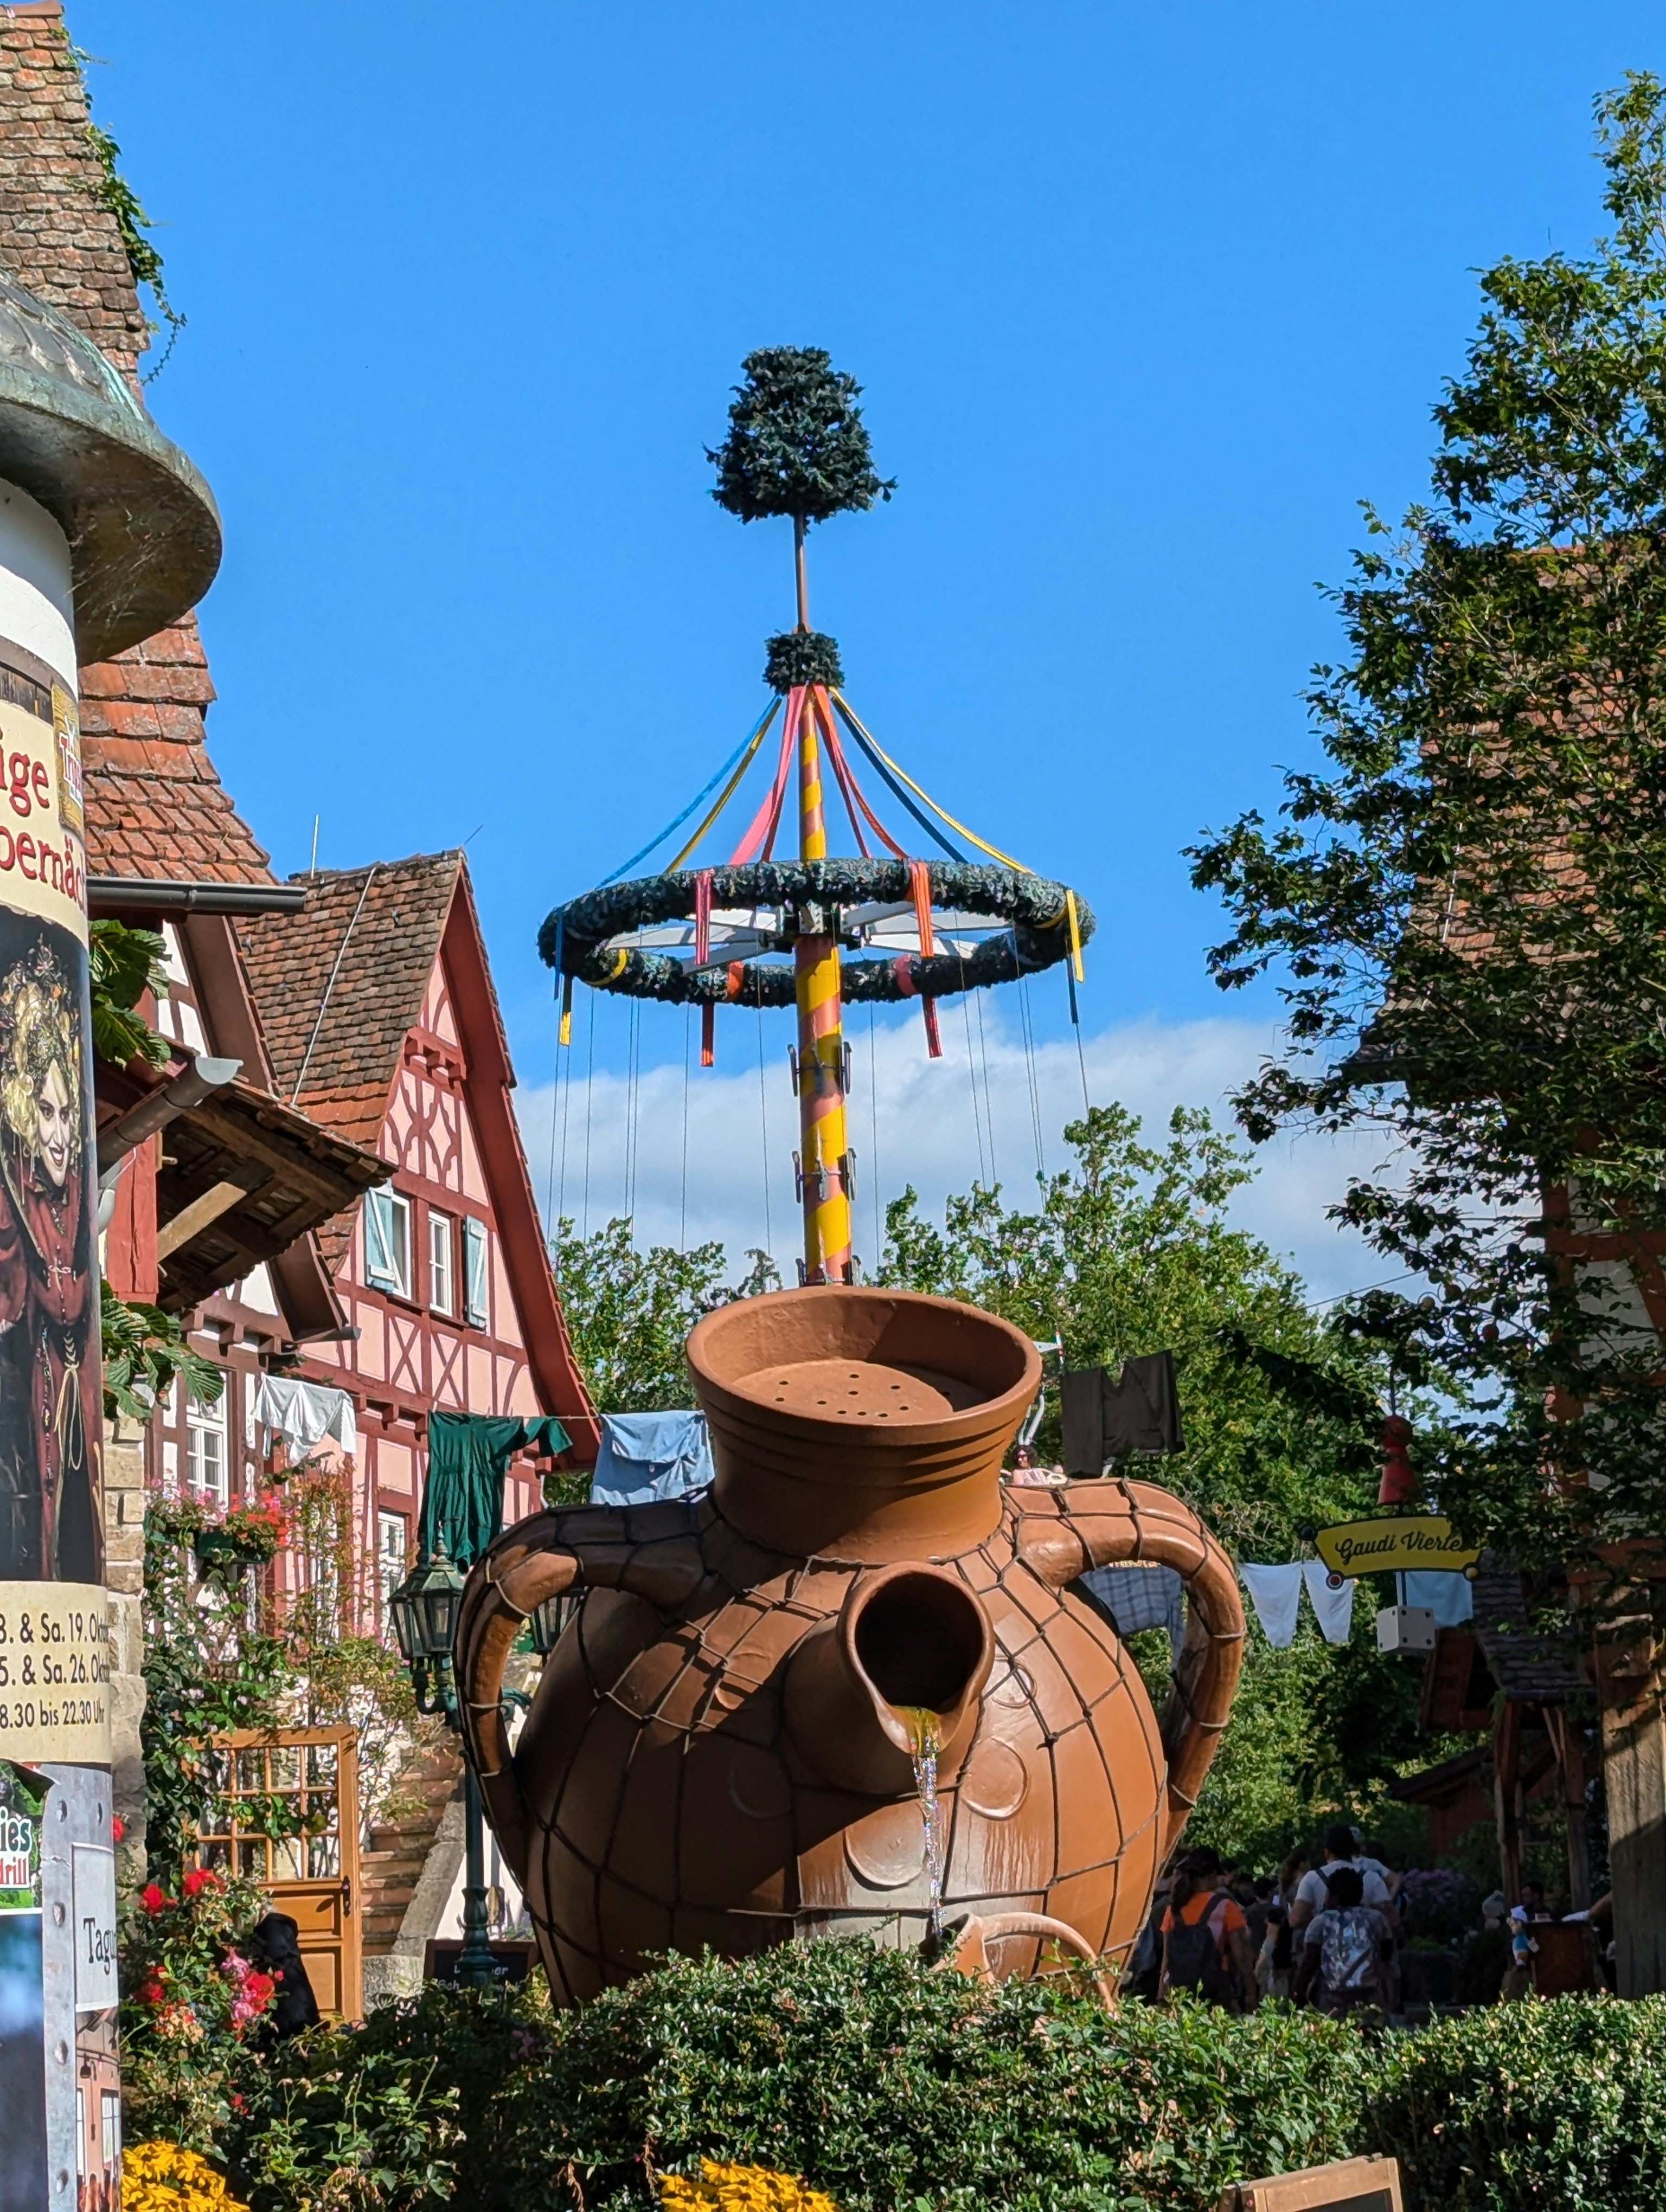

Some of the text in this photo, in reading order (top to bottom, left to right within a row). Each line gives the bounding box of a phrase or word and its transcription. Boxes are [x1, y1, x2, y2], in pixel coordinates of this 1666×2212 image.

[1335, 1531, 1468, 1566] Gaudi Vierte
[20, 1613, 35, 1644] &
[41, 1612, 65, 1643] Sa.
[68, 1612, 87, 1643] 19.
[0, 1655, 16, 1687] 5.
[22, 1654, 37, 1686] &
[43, 1654, 67, 1684] Sa.
[69, 1653, 89, 1684] 26.
[40, 1699, 59, 1727] bis
[62, 1700, 91, 1725] 22.30
